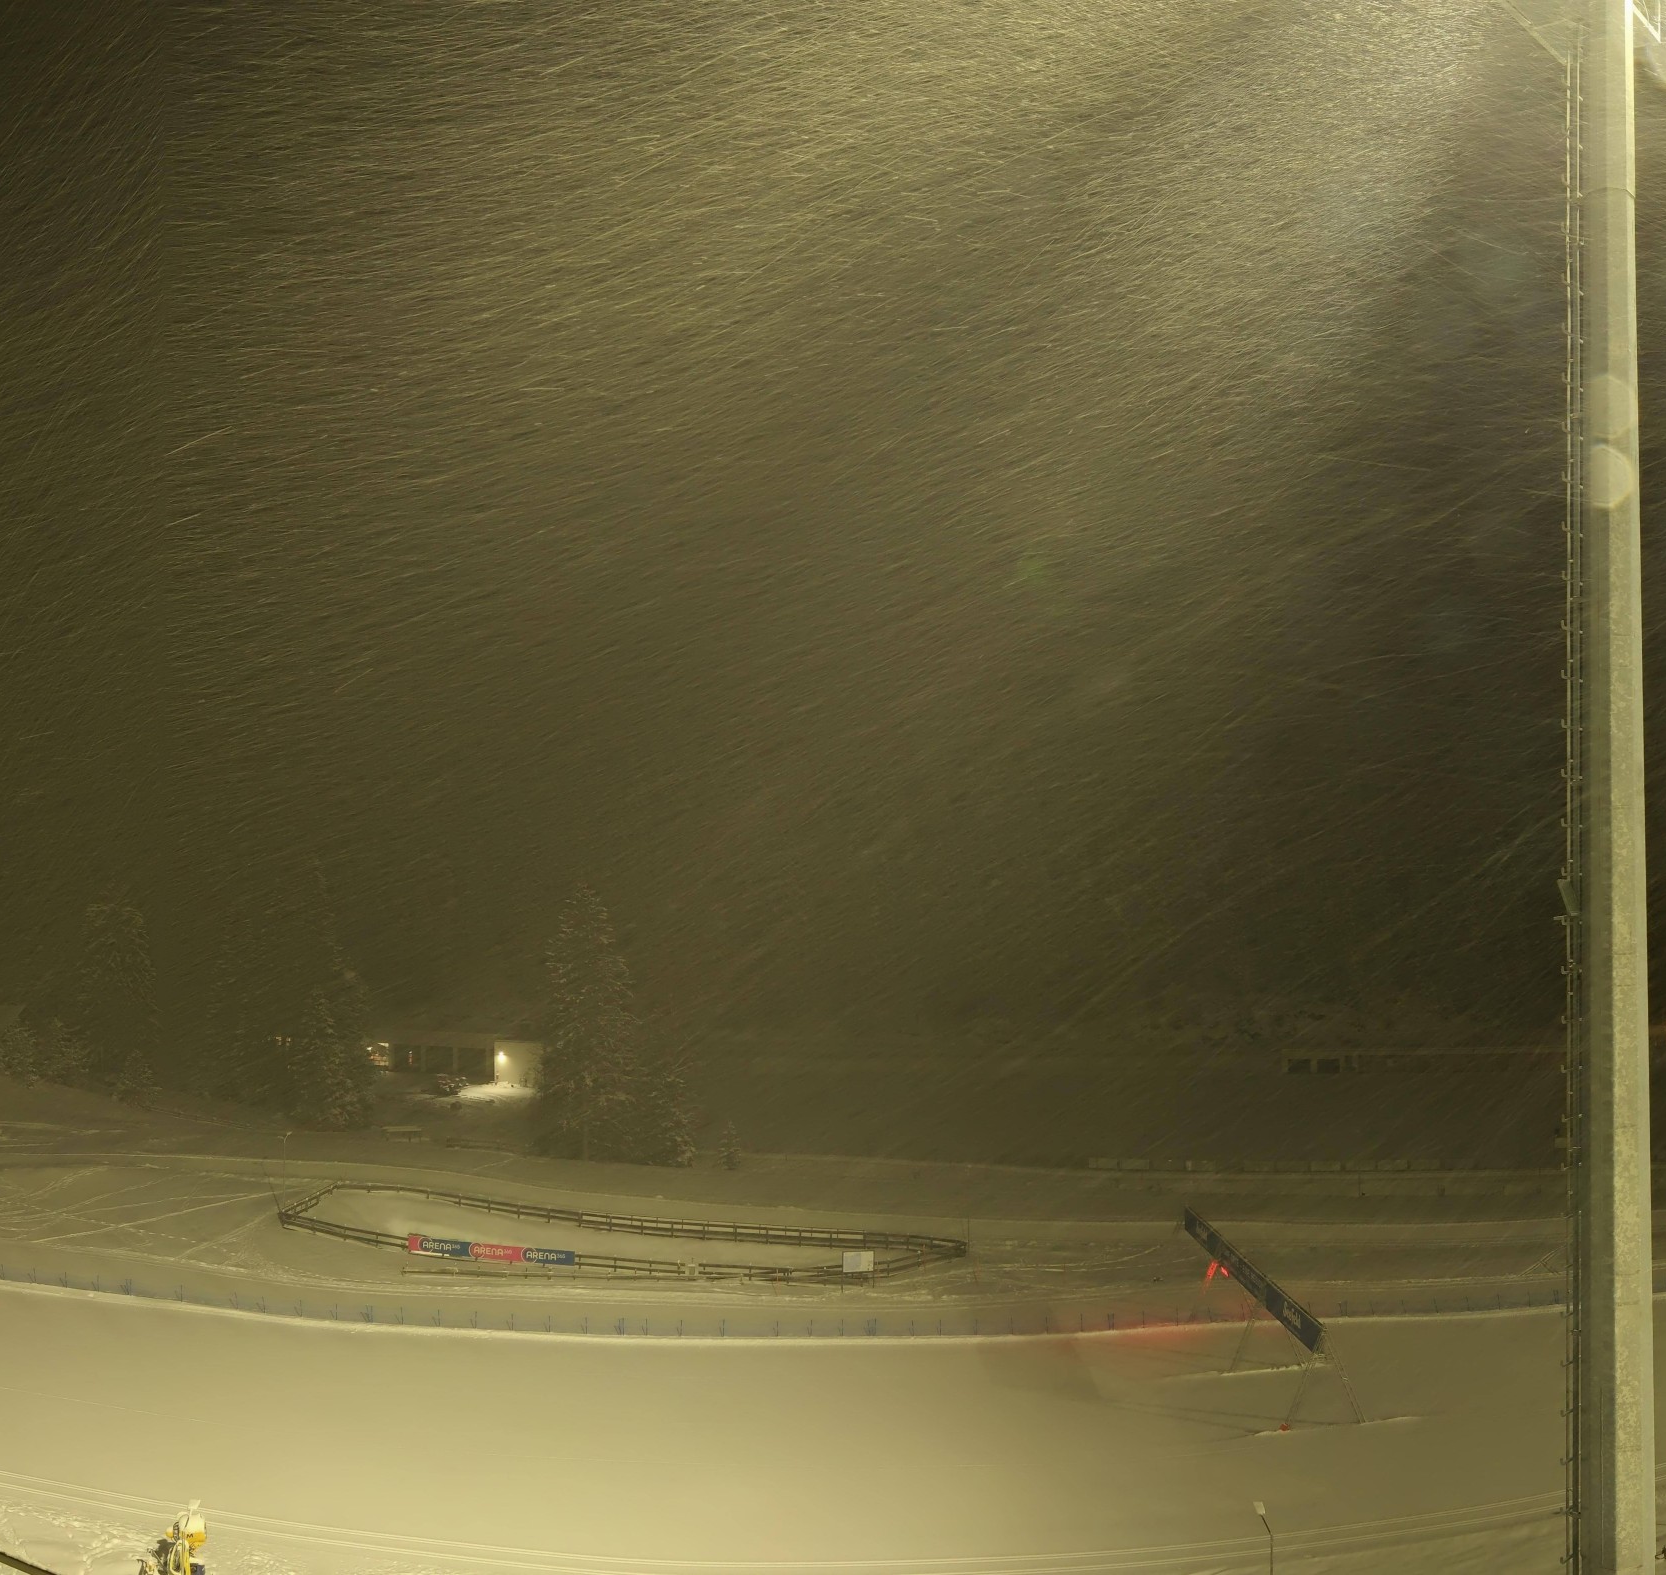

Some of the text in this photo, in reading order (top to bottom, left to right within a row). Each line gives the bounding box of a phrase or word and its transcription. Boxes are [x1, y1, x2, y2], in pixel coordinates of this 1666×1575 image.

[422, 1241, 451, 1251] ARENA
[474, 1246, 504, 1256] ARENA
[526, 1250, 557, 1260] ARENA
